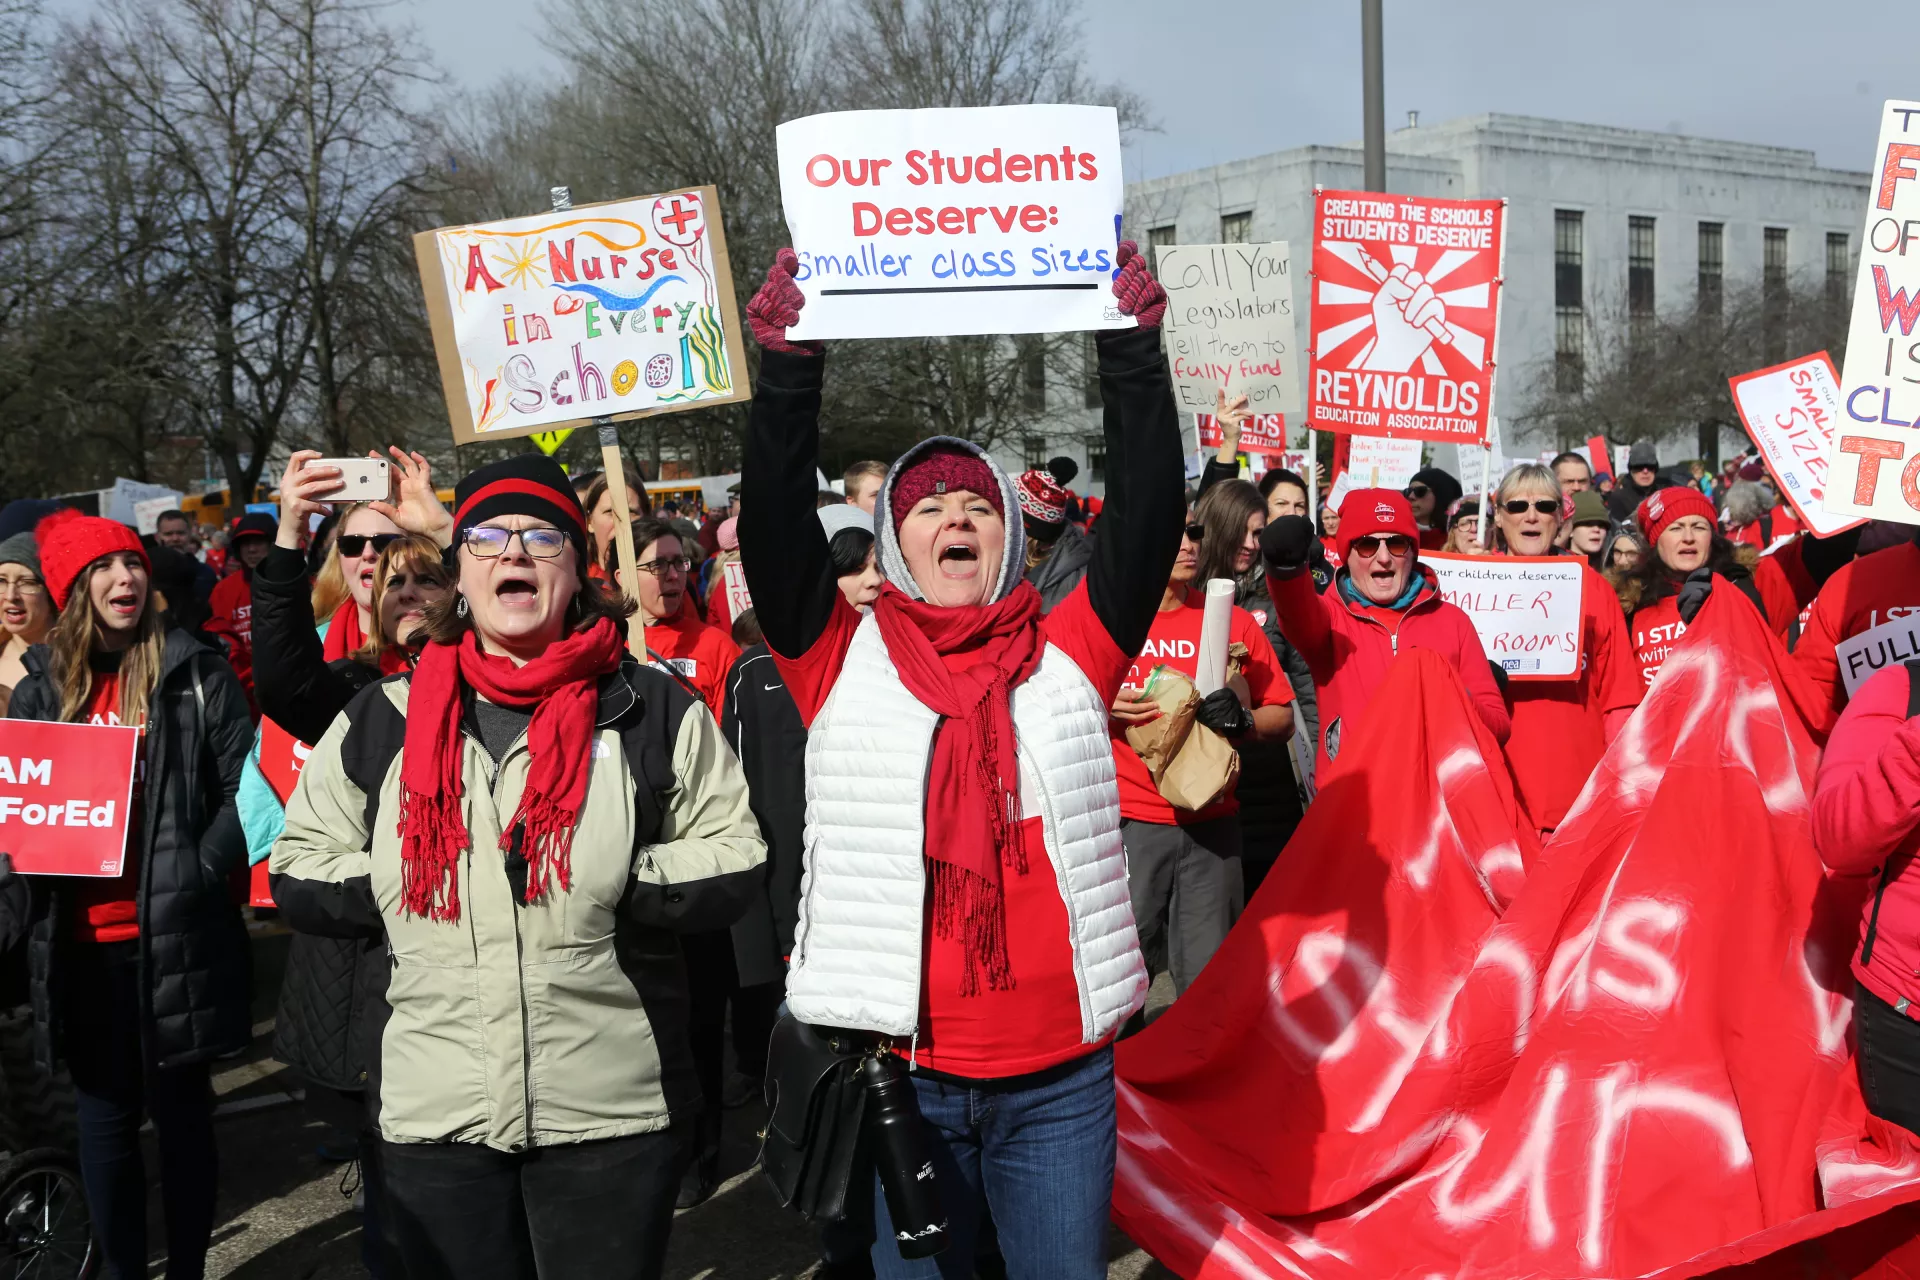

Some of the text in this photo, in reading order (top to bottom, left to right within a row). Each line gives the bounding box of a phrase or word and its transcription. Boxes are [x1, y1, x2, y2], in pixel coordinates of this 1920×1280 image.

[806, 146, 1098, 187] Our Students
[853, 202, 1058, 237] Deserve:
[1324, 199, 1493, 226] CREATING THE SCHOOLS
[1323, 218, 1492, 248] STUDENTS DESERVE
[465, 238, 678, 294] A Nurse
[932, 248, 1016, 280] class
[1160, 247, 1290, 292] Call Your
[503, 300, 697, 346] in Every
[1167, 296, 1291, 329] Legislators
[1167, 330, 1285, 357] Tell them to
[504, 333, 695, 414] School
[1174, 357, 1281, 387] fully fund
[1316, 368, 1480, 416] REYNOLDS
[1315, 405, 1478, 434] EDUCATION ASSOCIATION
[1459, 569, 1512, 580] children
[1519, 569, 1577, 581] deserve...
[1441, 590, 1552, 618] MALLER
[1494, 632, 1576, 653] ROOMS
[1650, 621, 1687, 643] STA
[1140, 639, 1196, 658] AND
[1502, 659, 1520, 669] nea
